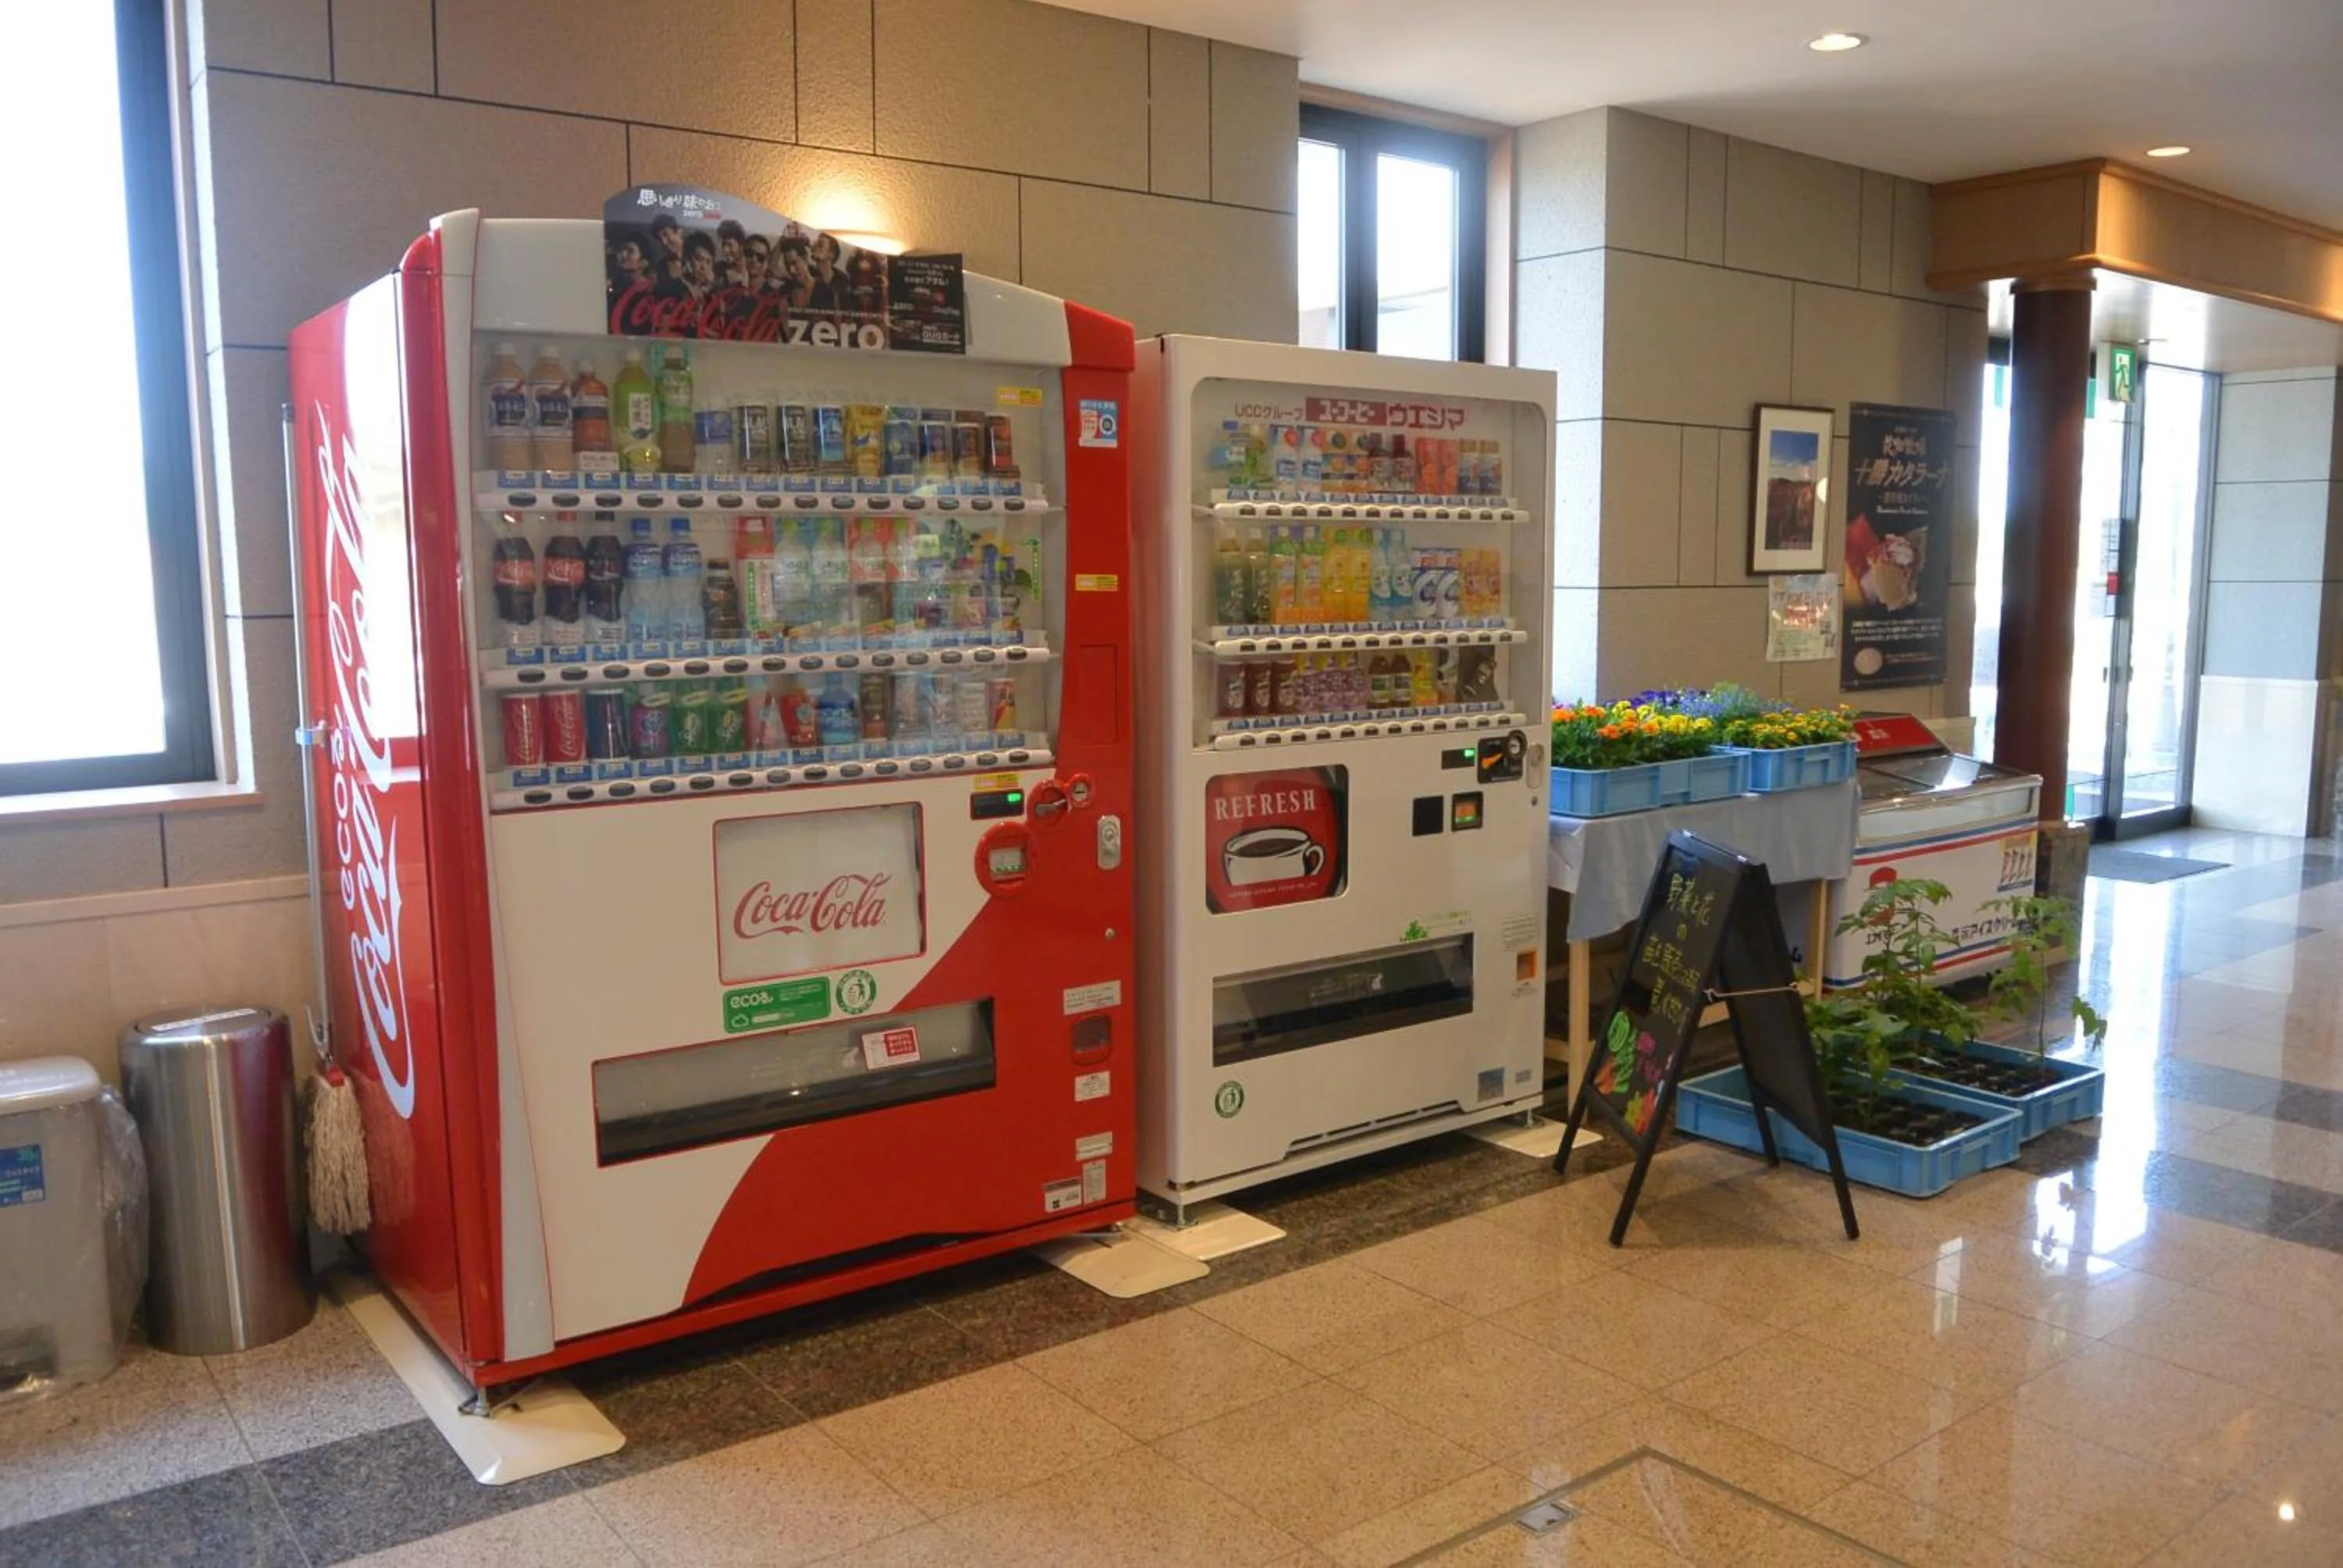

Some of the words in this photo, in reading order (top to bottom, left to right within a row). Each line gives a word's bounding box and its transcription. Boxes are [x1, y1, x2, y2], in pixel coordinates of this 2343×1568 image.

[787, 319, 884, 350] zero
[1389, 403, 1465, 430] ウエシマ
[1214, 789, 1316, 821] REFRESH
[733, 872, 892, 939] Coca-Cola
